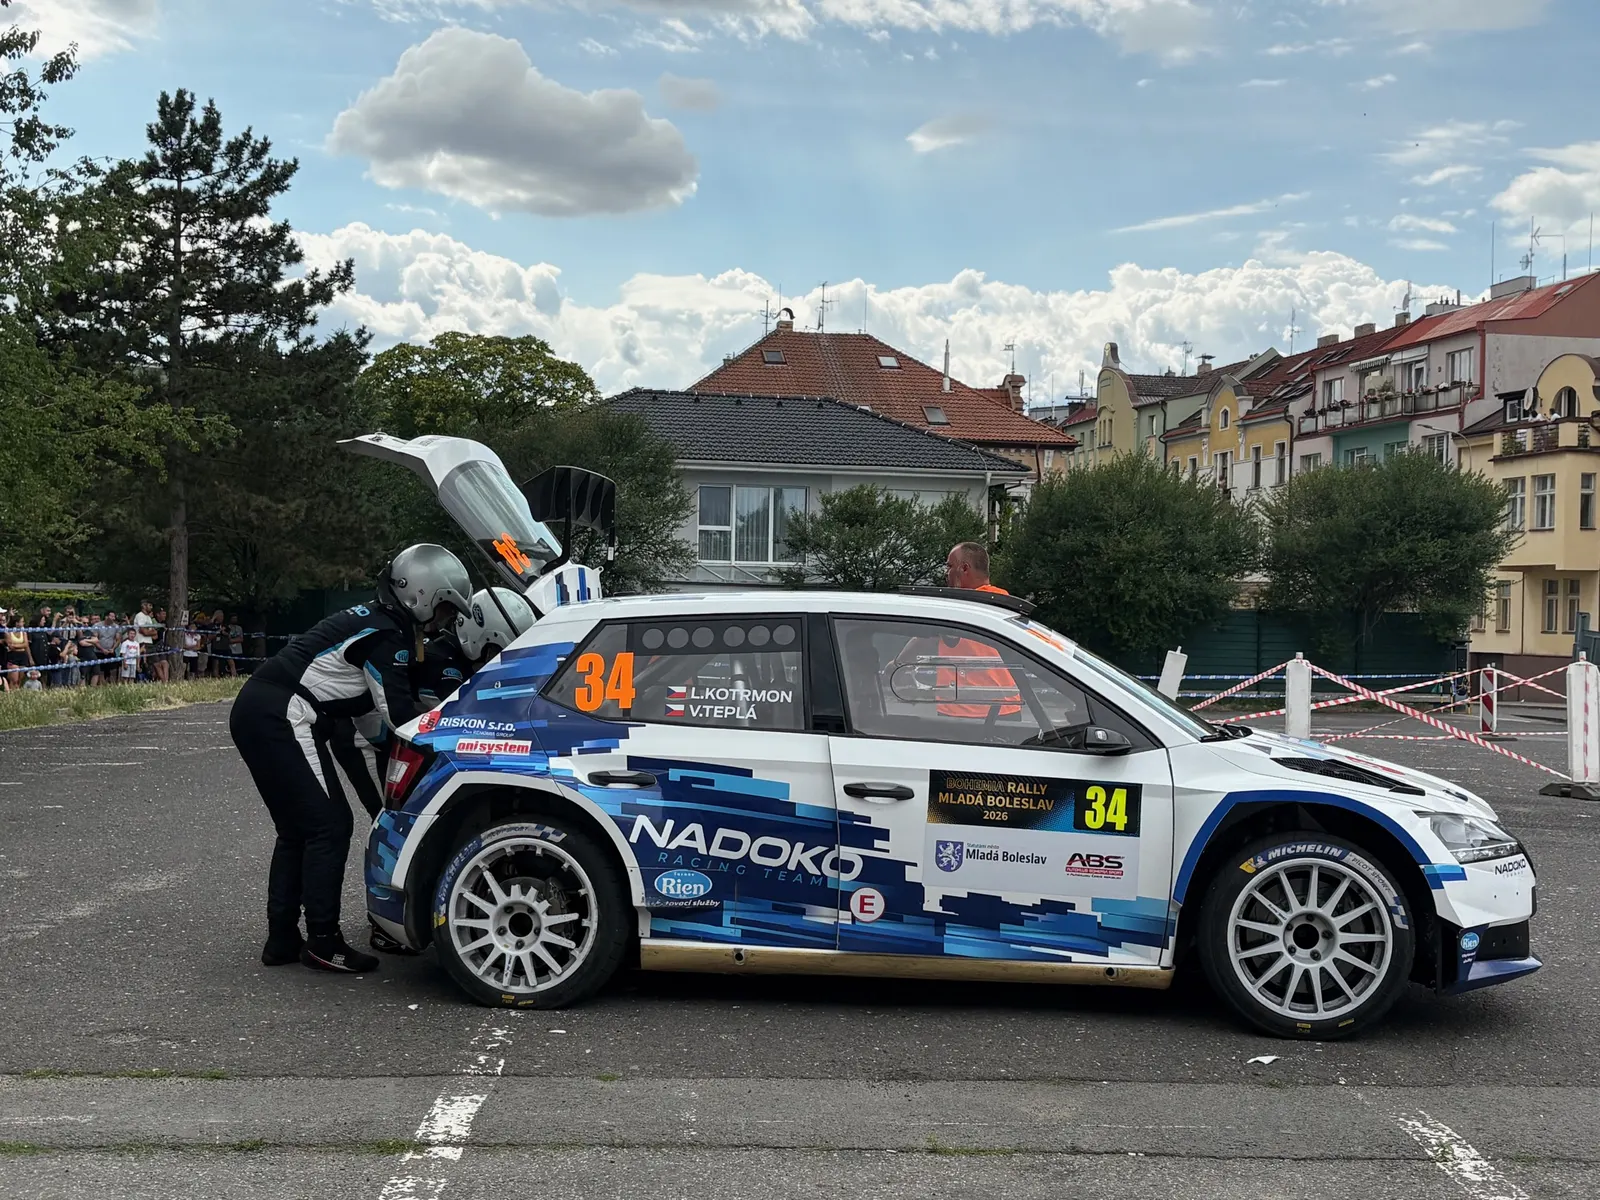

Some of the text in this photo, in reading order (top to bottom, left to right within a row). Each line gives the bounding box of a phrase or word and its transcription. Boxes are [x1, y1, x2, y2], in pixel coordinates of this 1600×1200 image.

[575, 652, 635, 712] 34
[690, 687, 793, 703] L.KOTRMON
[690, 703, 758, 720] V.TEPLÁ
[440, 717, 516, 732] RISKON s.r.o.
[947, 778, 1047, 795] BOHEMIA RALLY
[938, 791, 1054, 811] MLADÁ BOLESLAV
[1085, 786, 1128, 831] 34
[983, 810, 1008, 821] 2026
[629, 815, 864, 881] NADOKO
[965, 848, 1047, 865] Mladá Boleslav
[1268, 844, 1342, 860] MICHELIN
[657, 852, 823, 887] RACING TEAM
[1066, 853, 1123, 869] ABS
[1495, 859, 1526, 875] NADOKO
[662, 877, 705, 895] Rien
[859, 895, 875, 914] E
